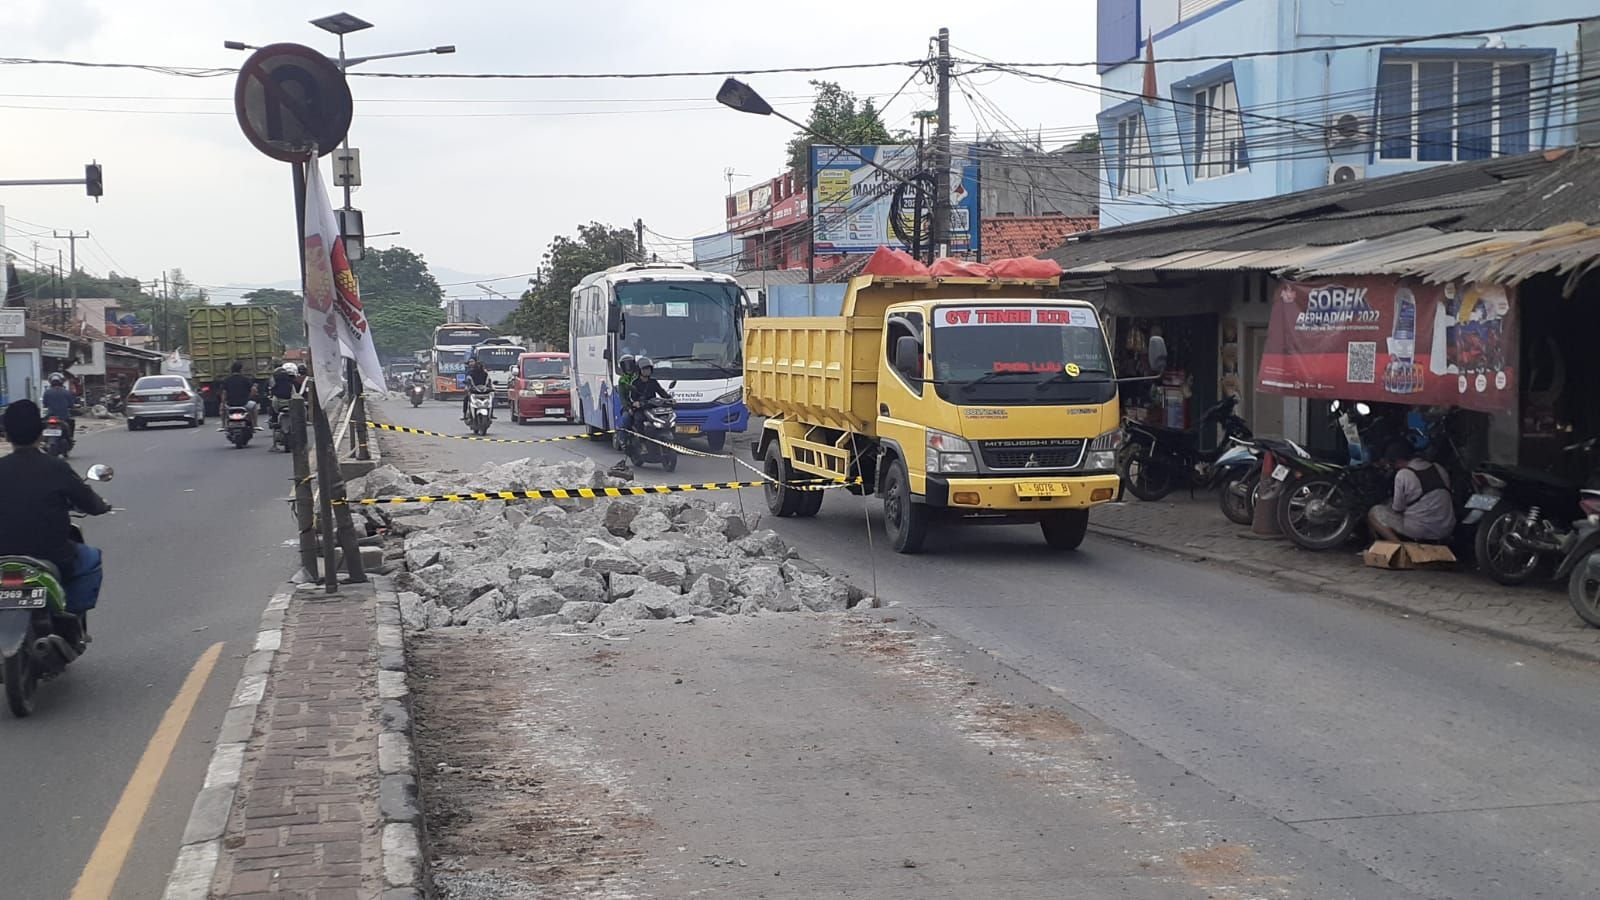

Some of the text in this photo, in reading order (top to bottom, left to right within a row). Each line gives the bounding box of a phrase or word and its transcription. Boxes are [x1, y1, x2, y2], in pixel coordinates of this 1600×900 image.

[1308, 287, 1368, 310] SOBEK
[945, 310, 971, 325] CV
[1296, 310, 1380, 324] BERHADIAH 2022
